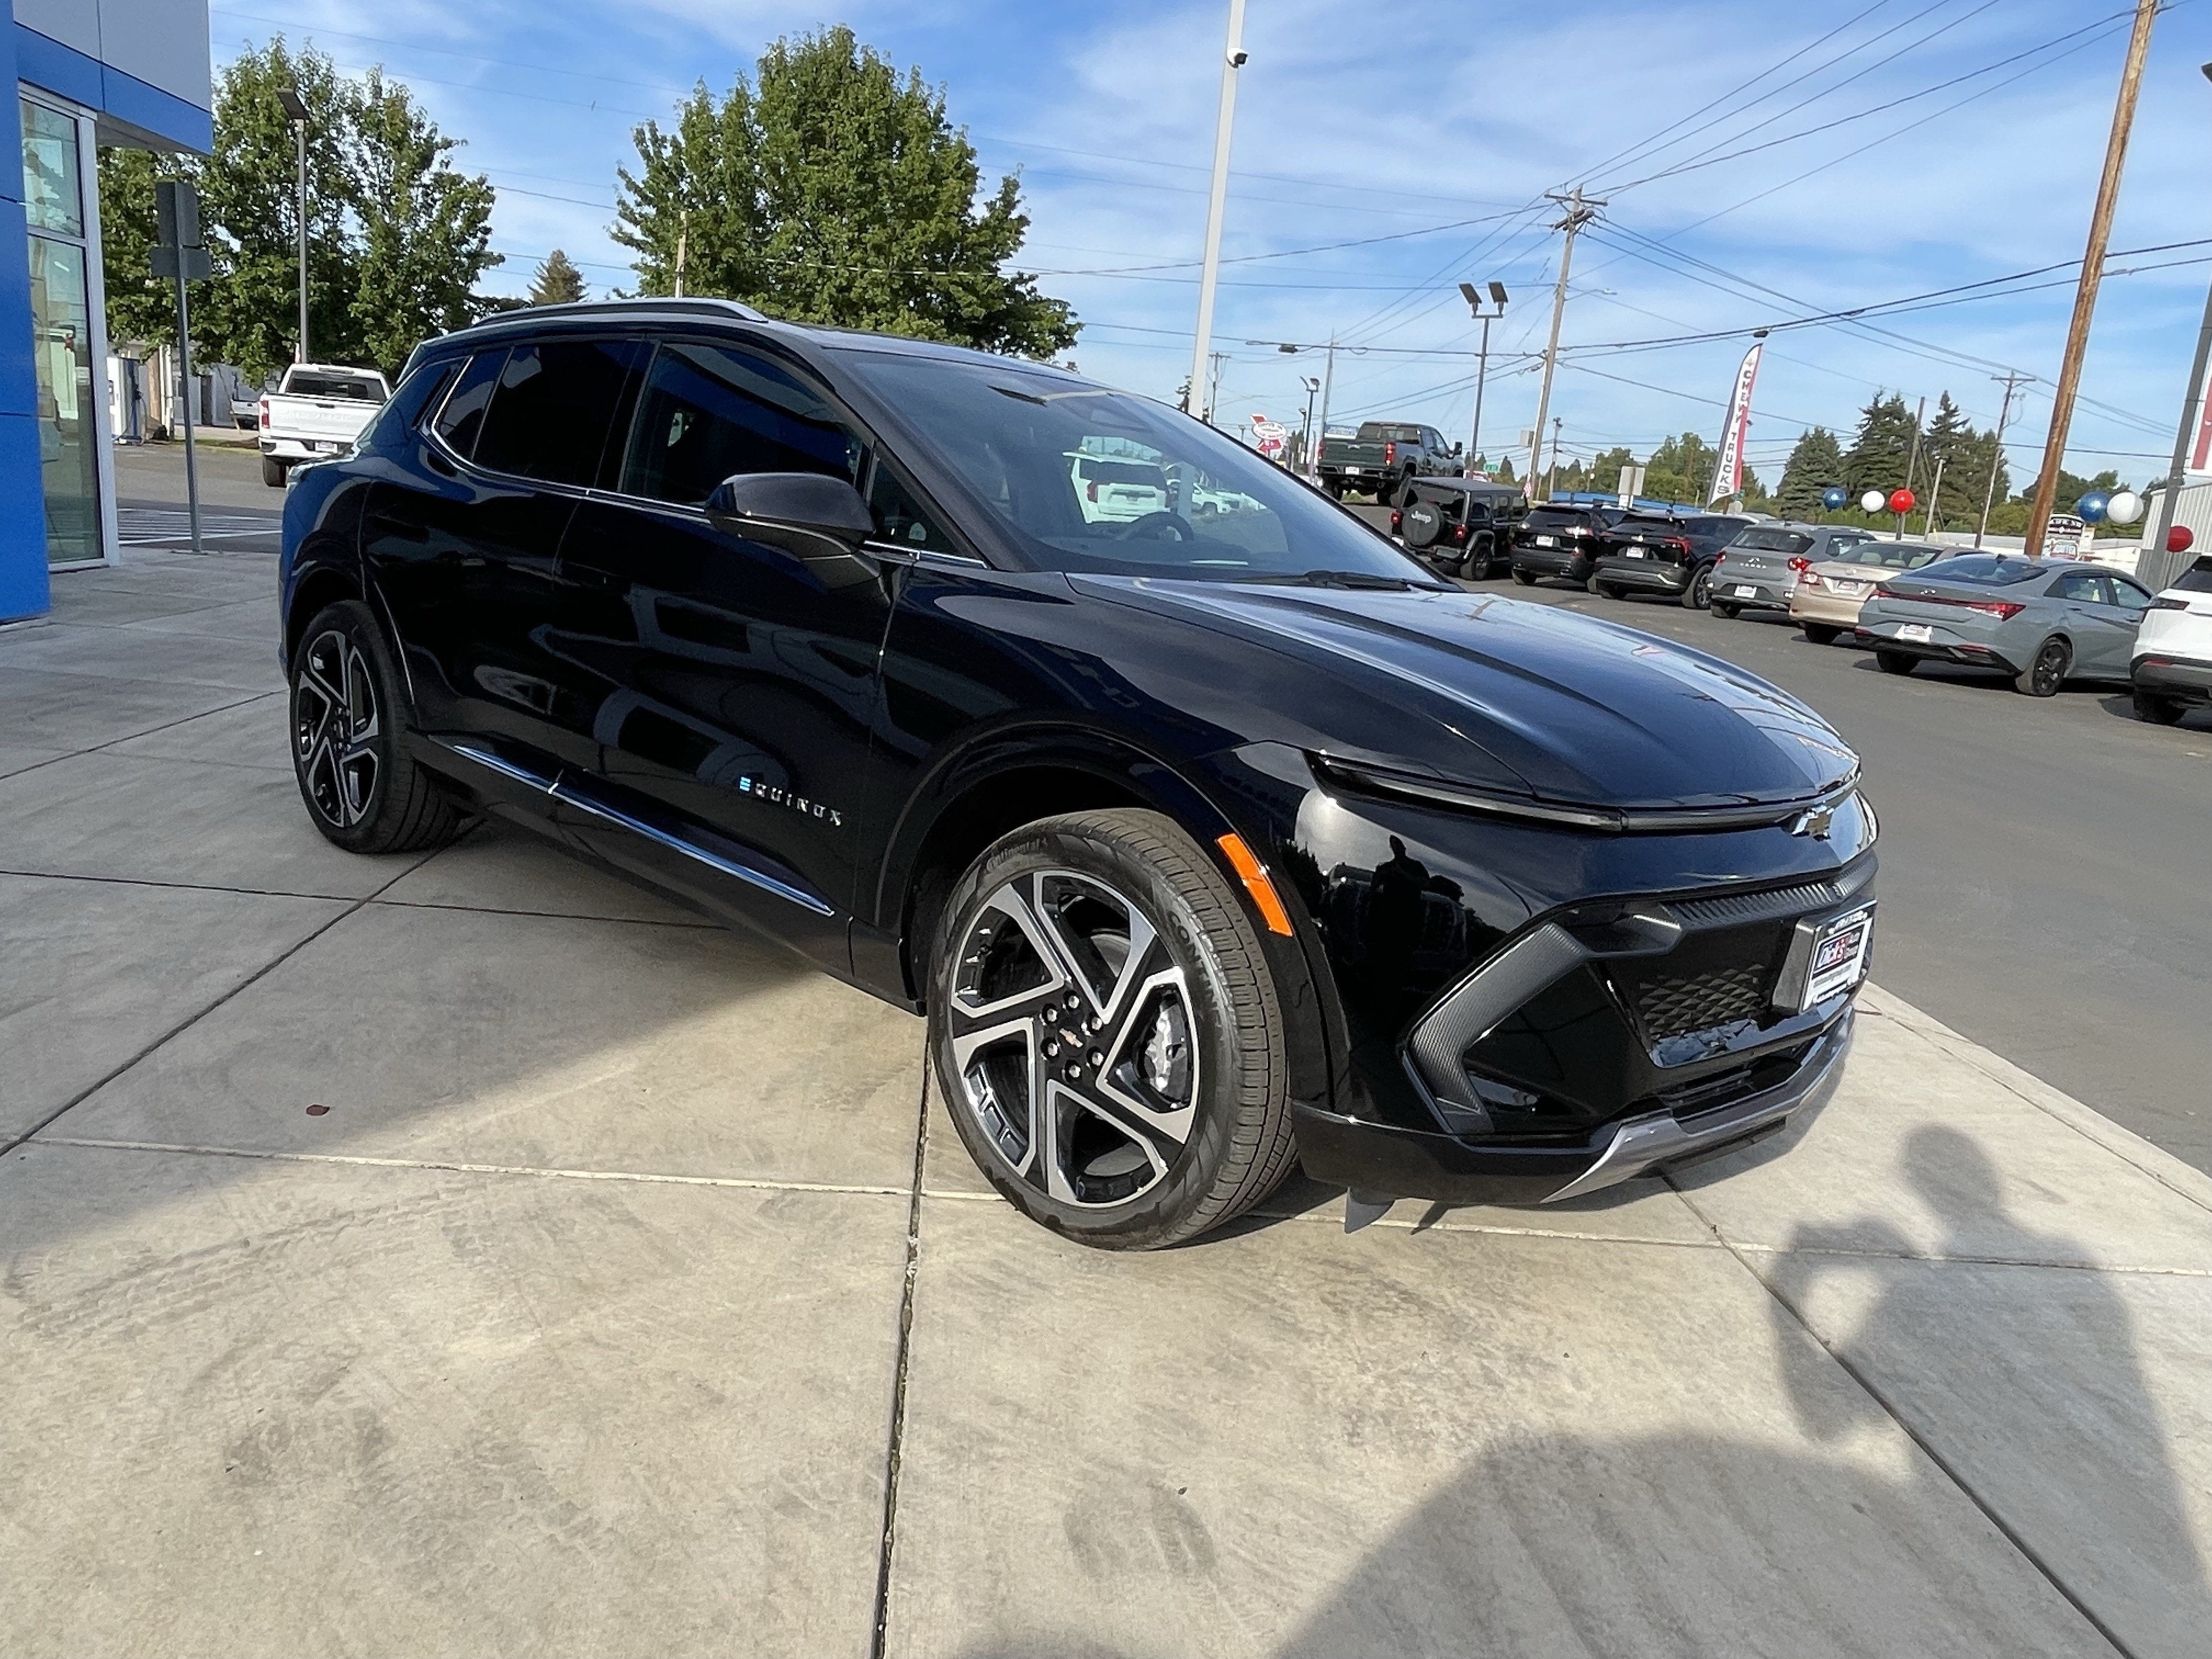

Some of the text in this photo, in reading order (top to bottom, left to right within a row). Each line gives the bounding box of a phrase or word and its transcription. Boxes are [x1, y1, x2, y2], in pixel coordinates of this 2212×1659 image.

[1717, 431, 1737, 494] TRUCKS
[1411, 510, 1432, 523] Jeep
[739, 776, 842, 826] EQUINOX
